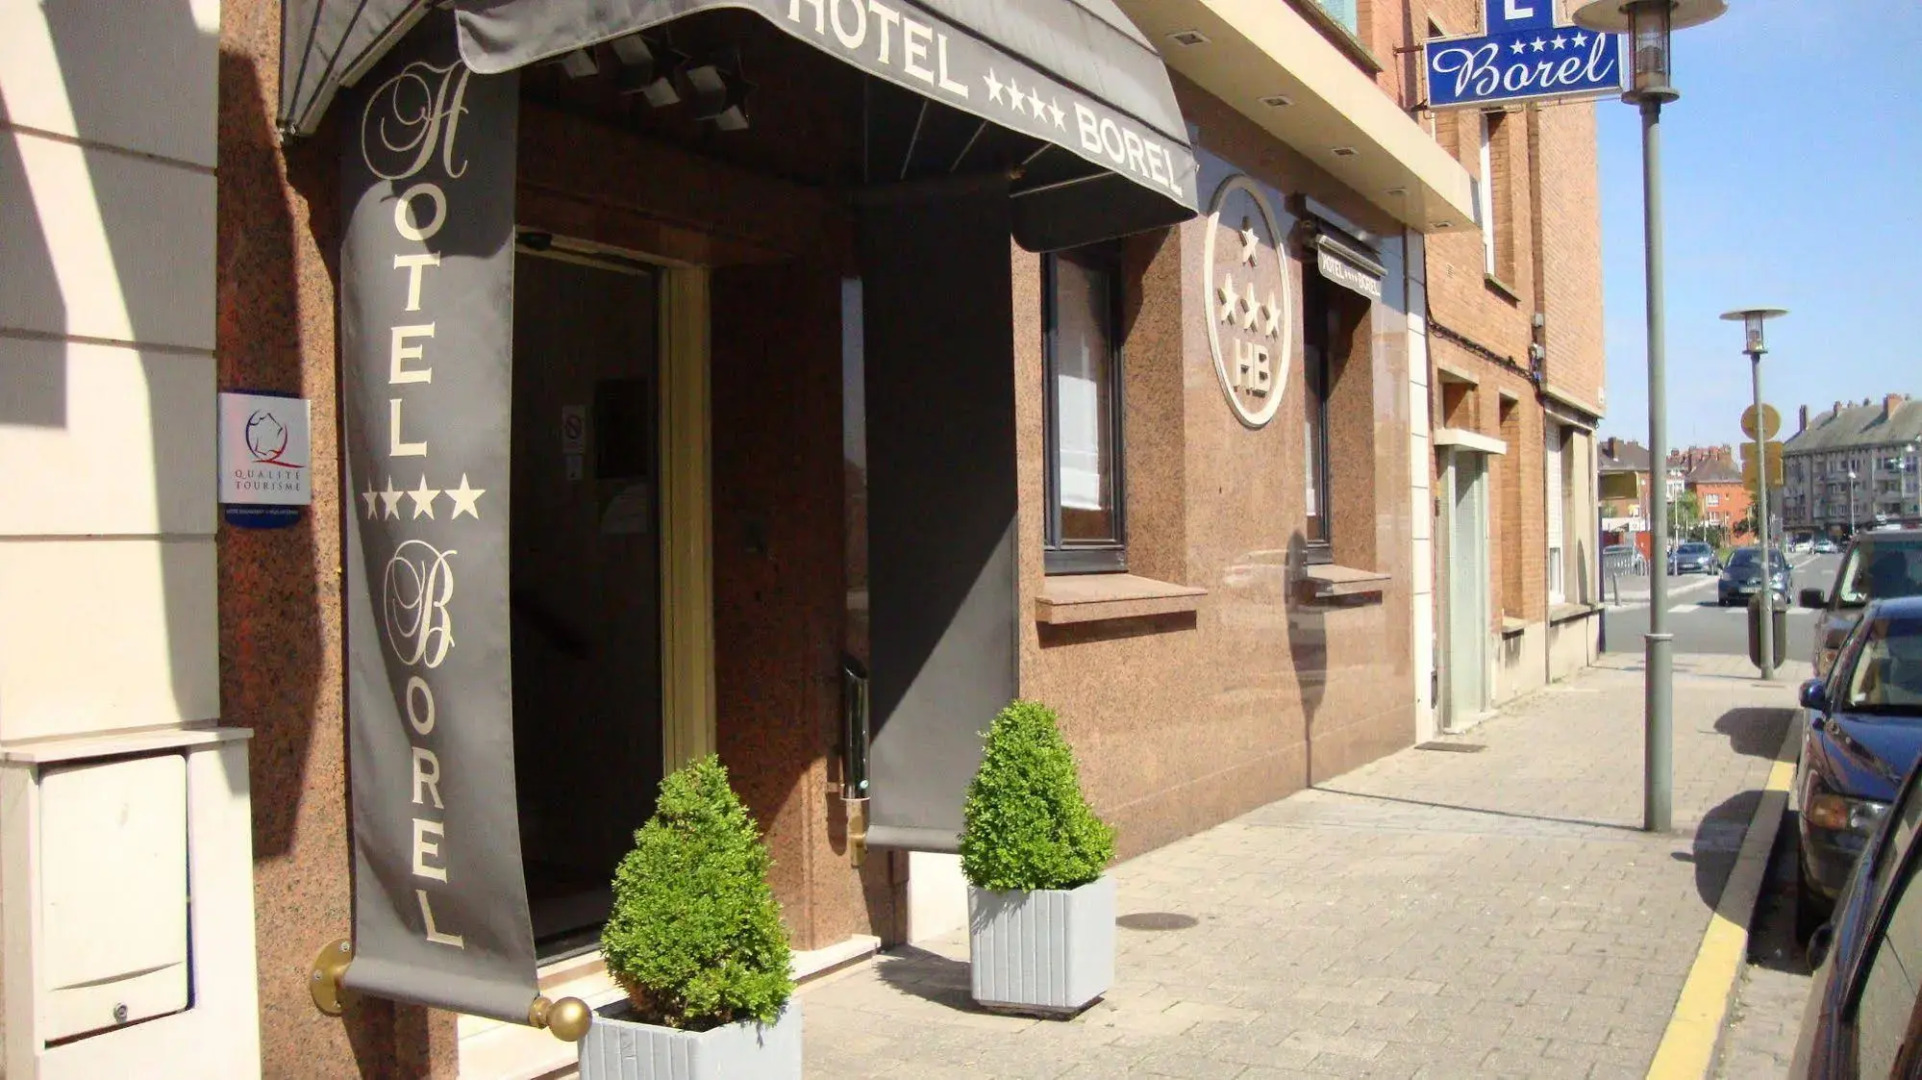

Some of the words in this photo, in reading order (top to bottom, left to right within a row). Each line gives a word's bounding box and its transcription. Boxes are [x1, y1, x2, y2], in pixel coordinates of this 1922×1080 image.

[787, 0, 968, 99] HOTEL
[1075, 102, 1183, 198] BOREL
[1432, 32, 1615, 98] Borel
[361, 60, 470, 459] HOTEL
[1234, 338, 1271, 395] HB
[236, 481, 300, 492] TOURISME
[384, 539, 465, 950] BOREL
